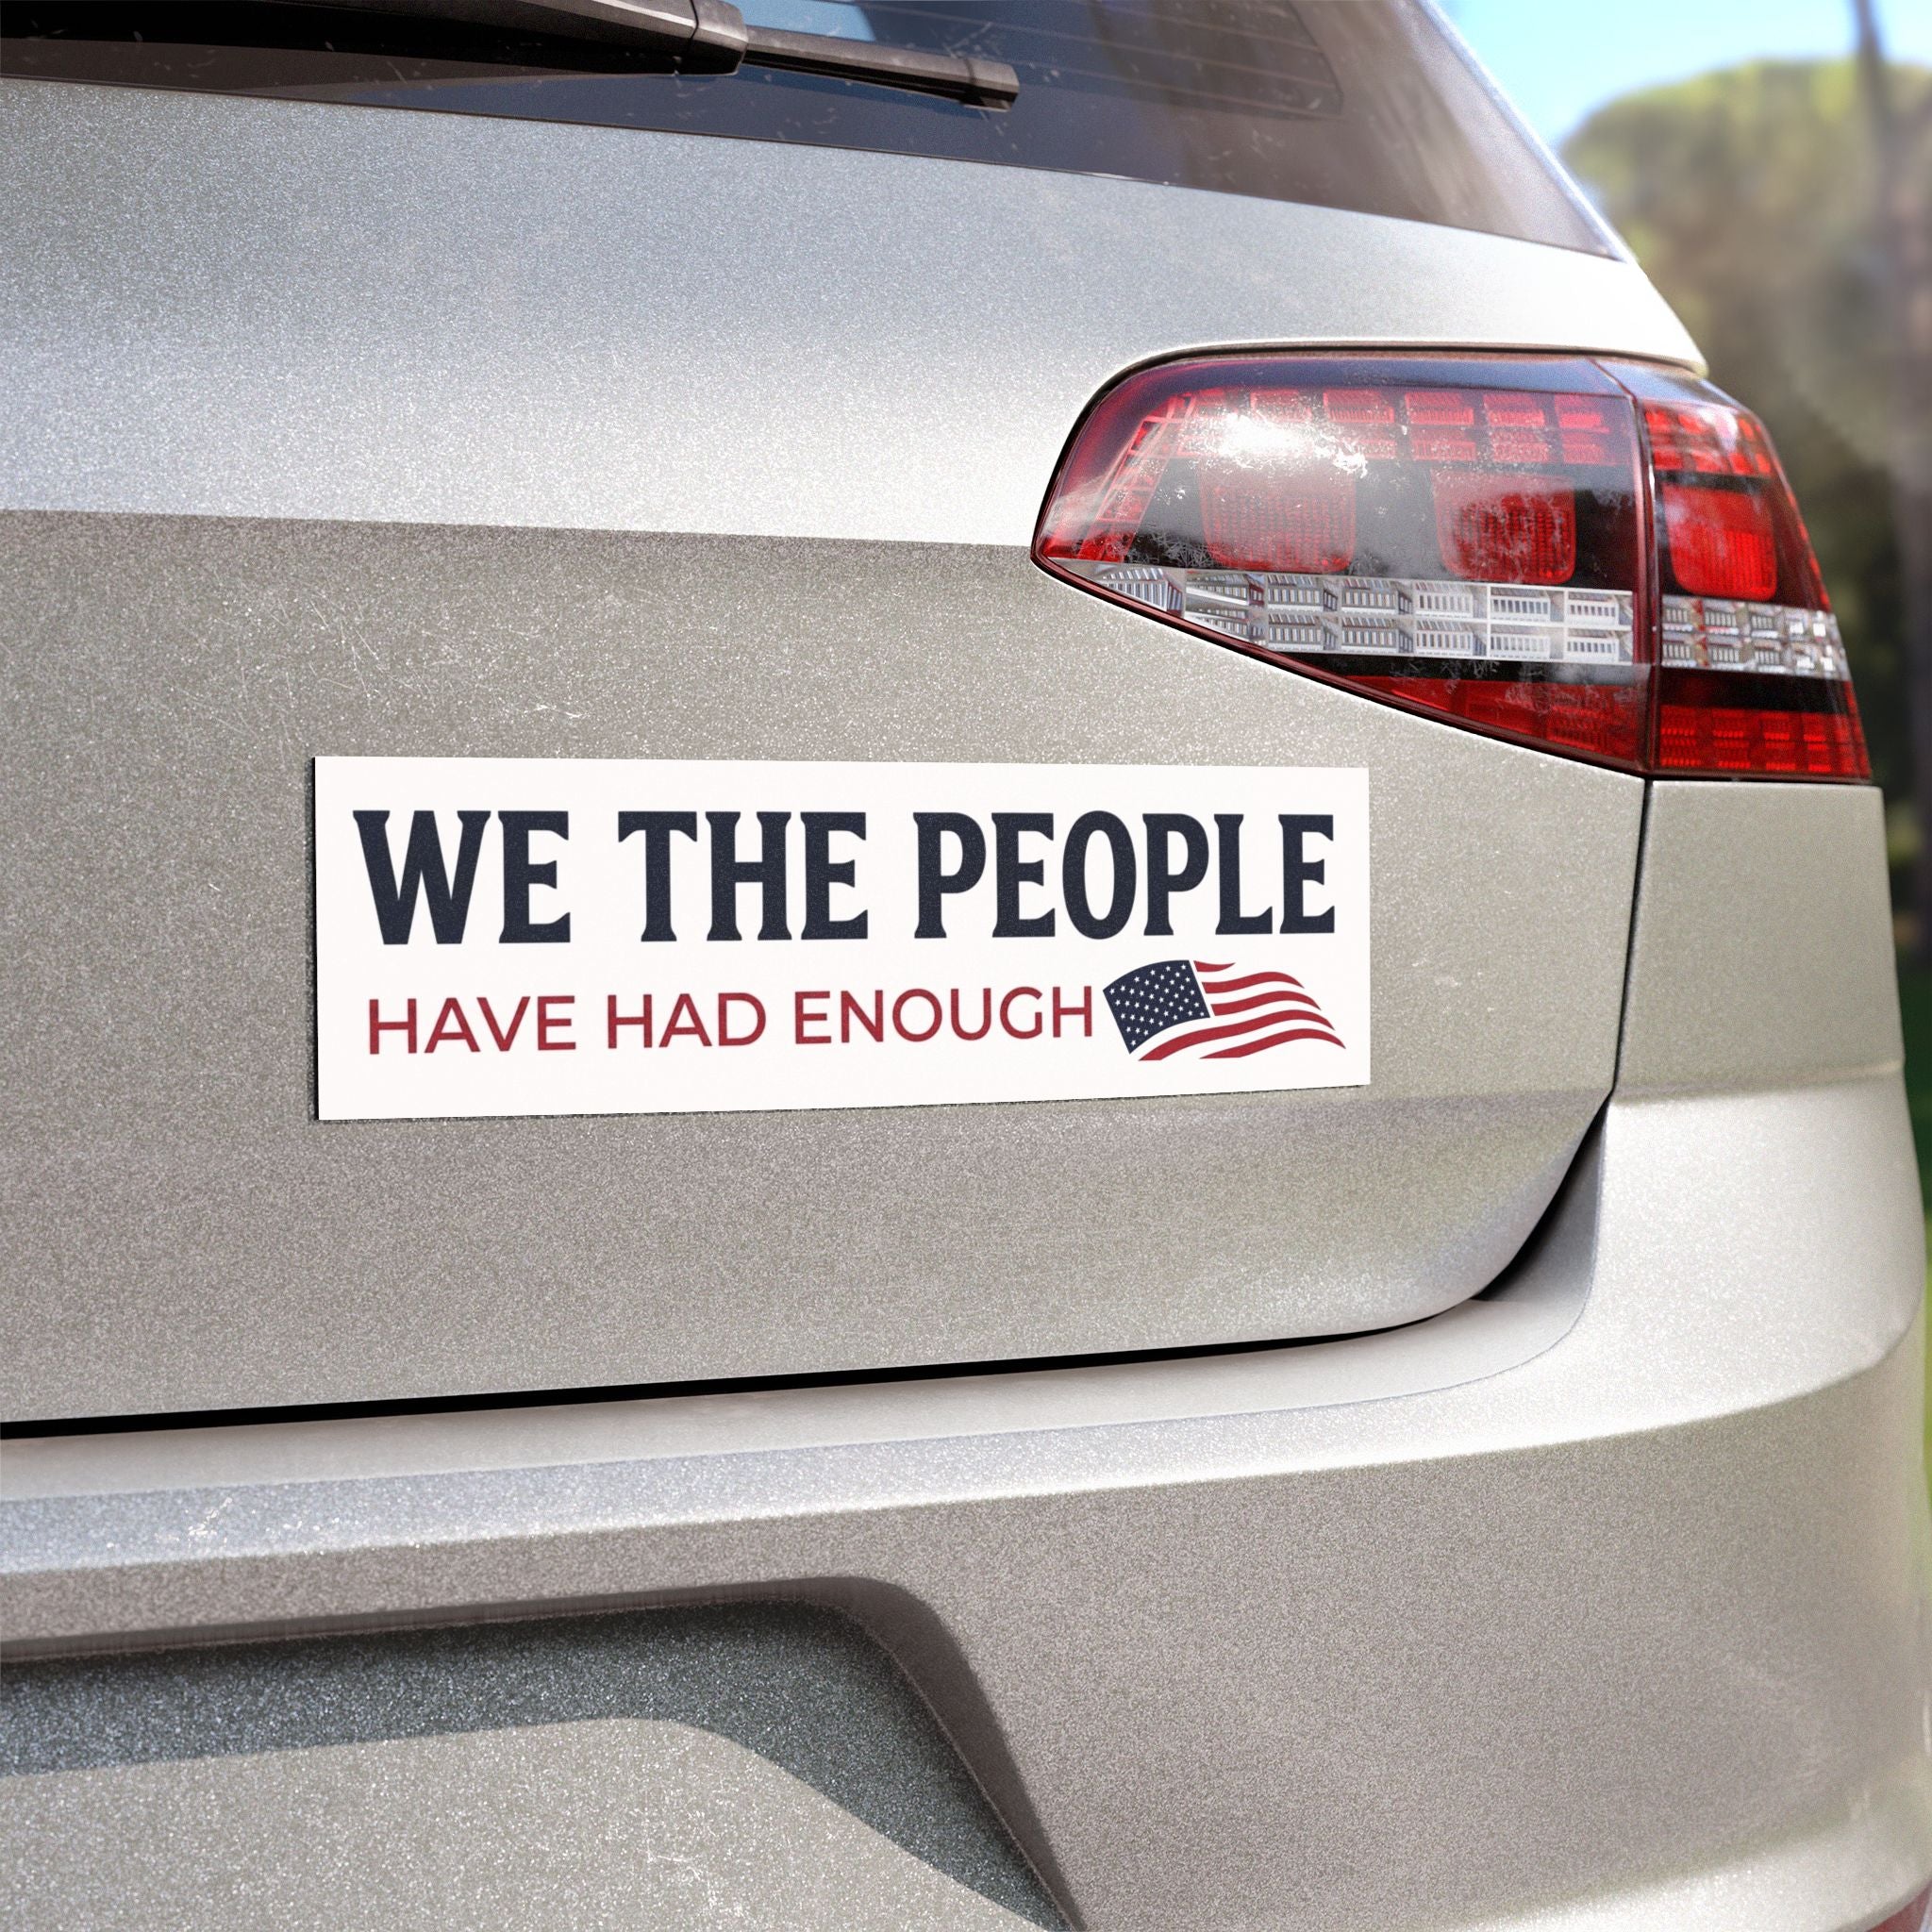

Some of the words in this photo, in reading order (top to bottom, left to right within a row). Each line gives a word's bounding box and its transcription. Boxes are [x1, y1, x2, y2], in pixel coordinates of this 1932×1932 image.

[353, 810, 572, 945] WE
[618, 811, 869, 942] THE
[913, 810, 1336, 941] PEOPLE
[369, 994, 577, 1056] HAVE
[607, 991, 767, 1050] HAD
[794, 985, 1092, 1045] ENOUGH
